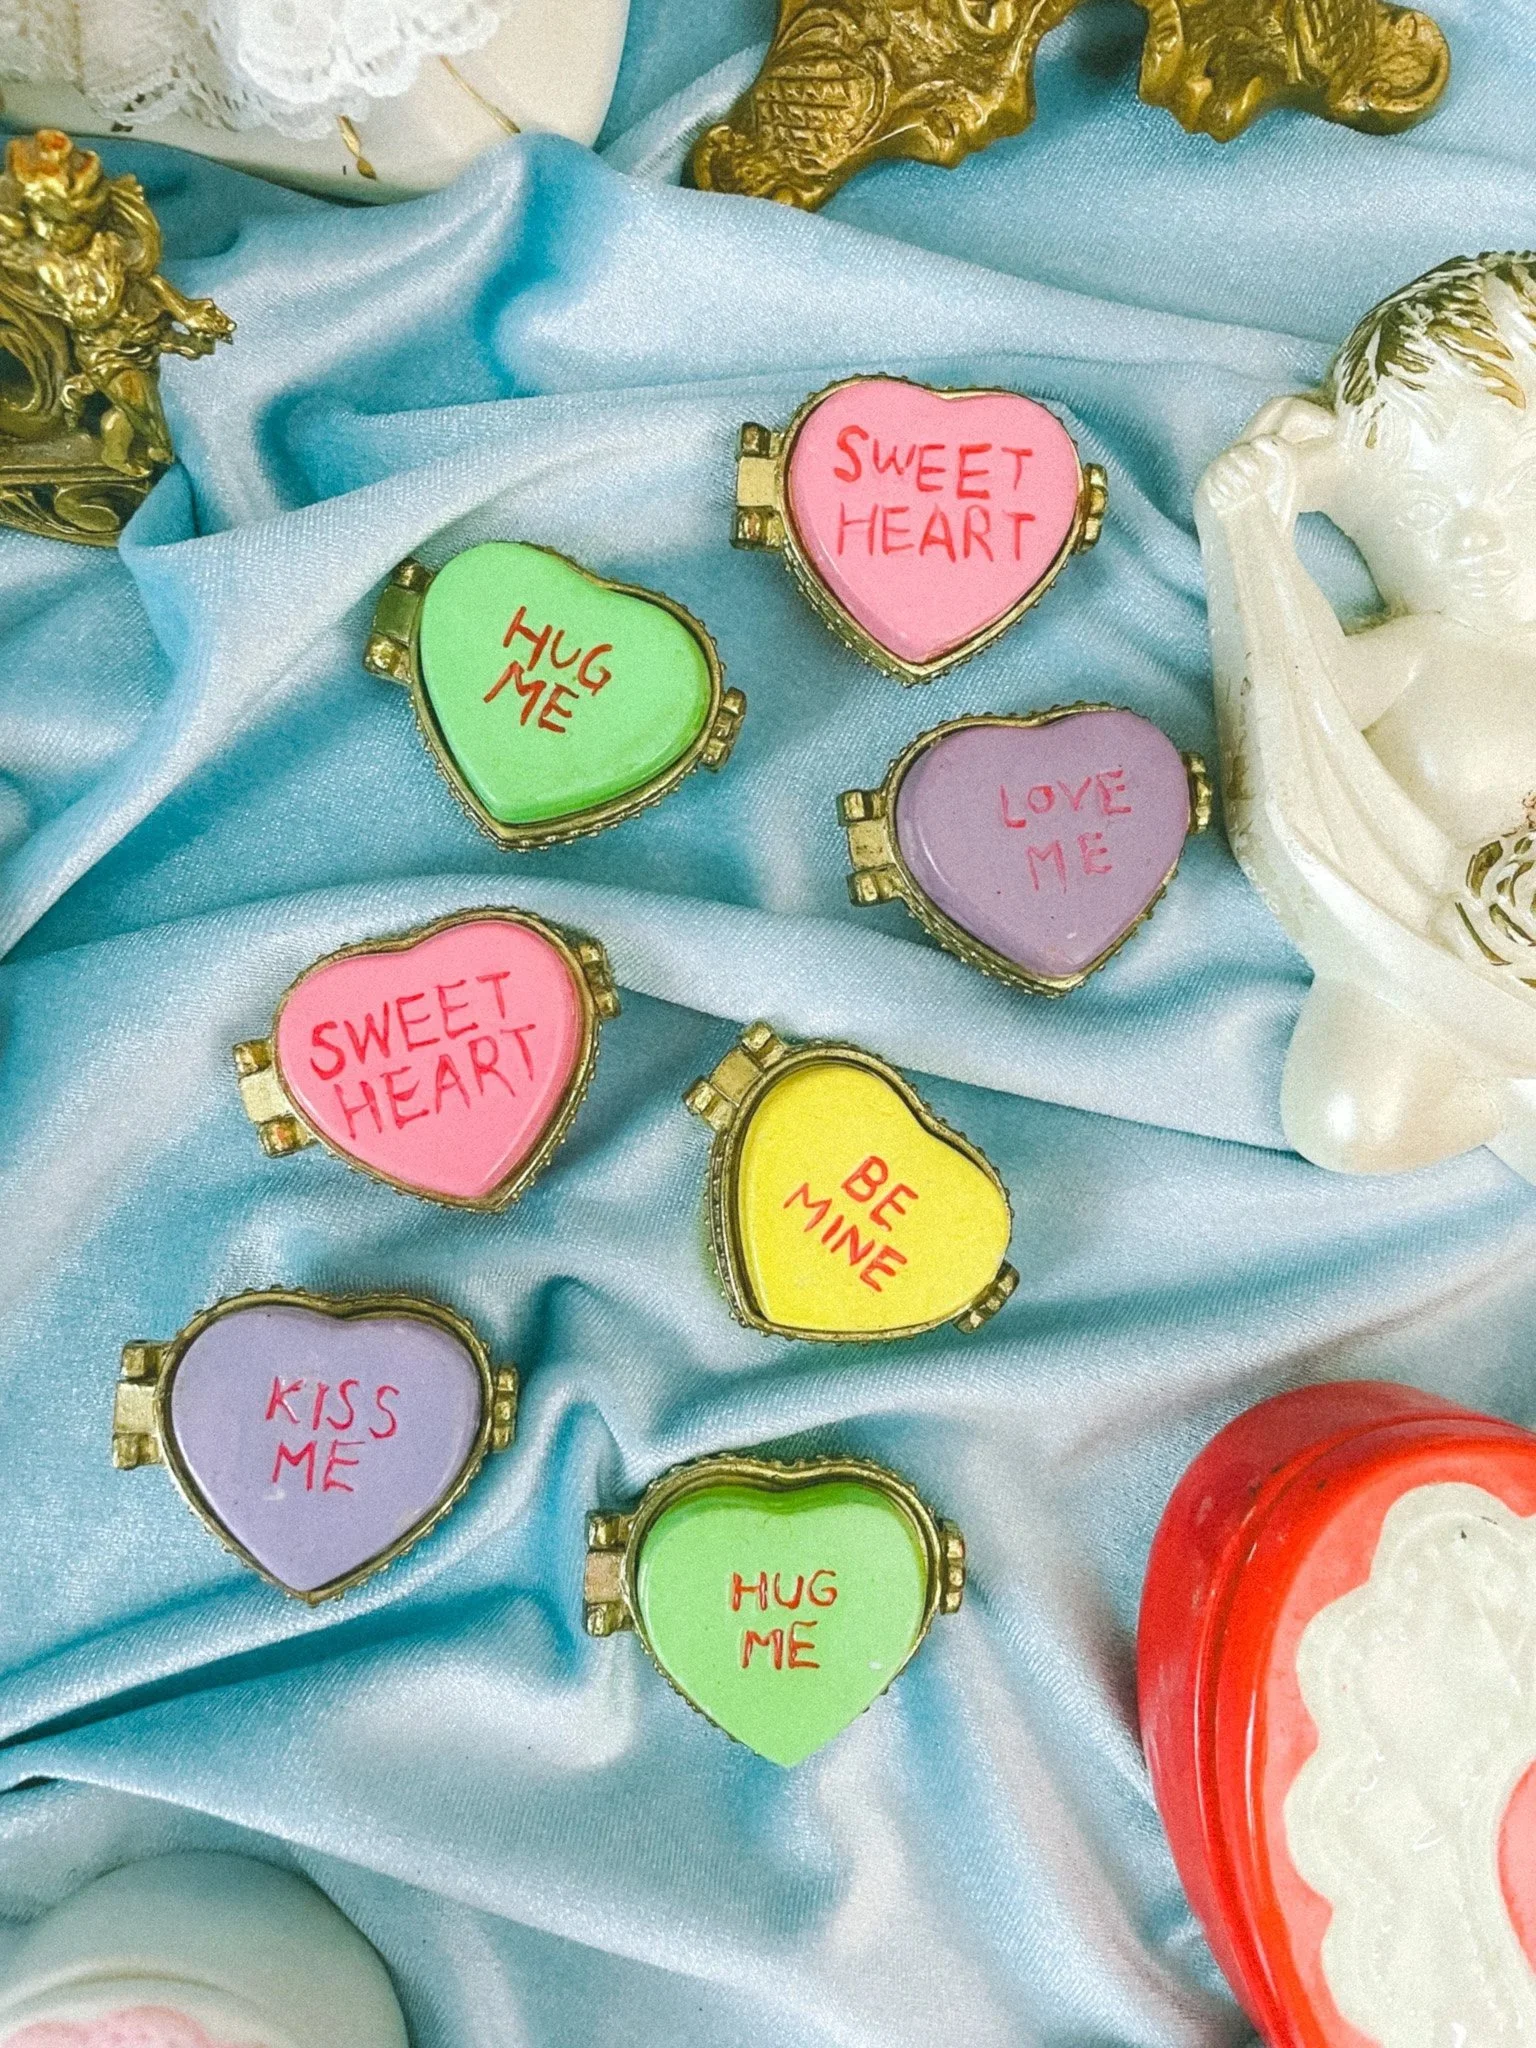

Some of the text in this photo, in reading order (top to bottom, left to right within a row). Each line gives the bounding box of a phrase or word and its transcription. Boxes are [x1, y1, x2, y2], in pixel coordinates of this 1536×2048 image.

[834, 424, 1033, 500] SWEET
[838, 505, 1036, 563] HEART
[502, 605, 613, 695] HUG
[484, 661, 582, 733] ME
[1000, 769, 1133, 830] LOVE
[1025, 832, 1113, 894] ME
[310, 970, 512, 1079] SWEET
[334, 1024, 537, 1139] HEART
[841, 1155, 919, 1232] BE
[783, 1183, 908, 1293] MINE
[265, 1376, 400, 1439] KISS
[271, 1438, 366, 1492] ME
[730, 1569, 839, 1610] HUG
[742, 1620, 821, 1669] ME
